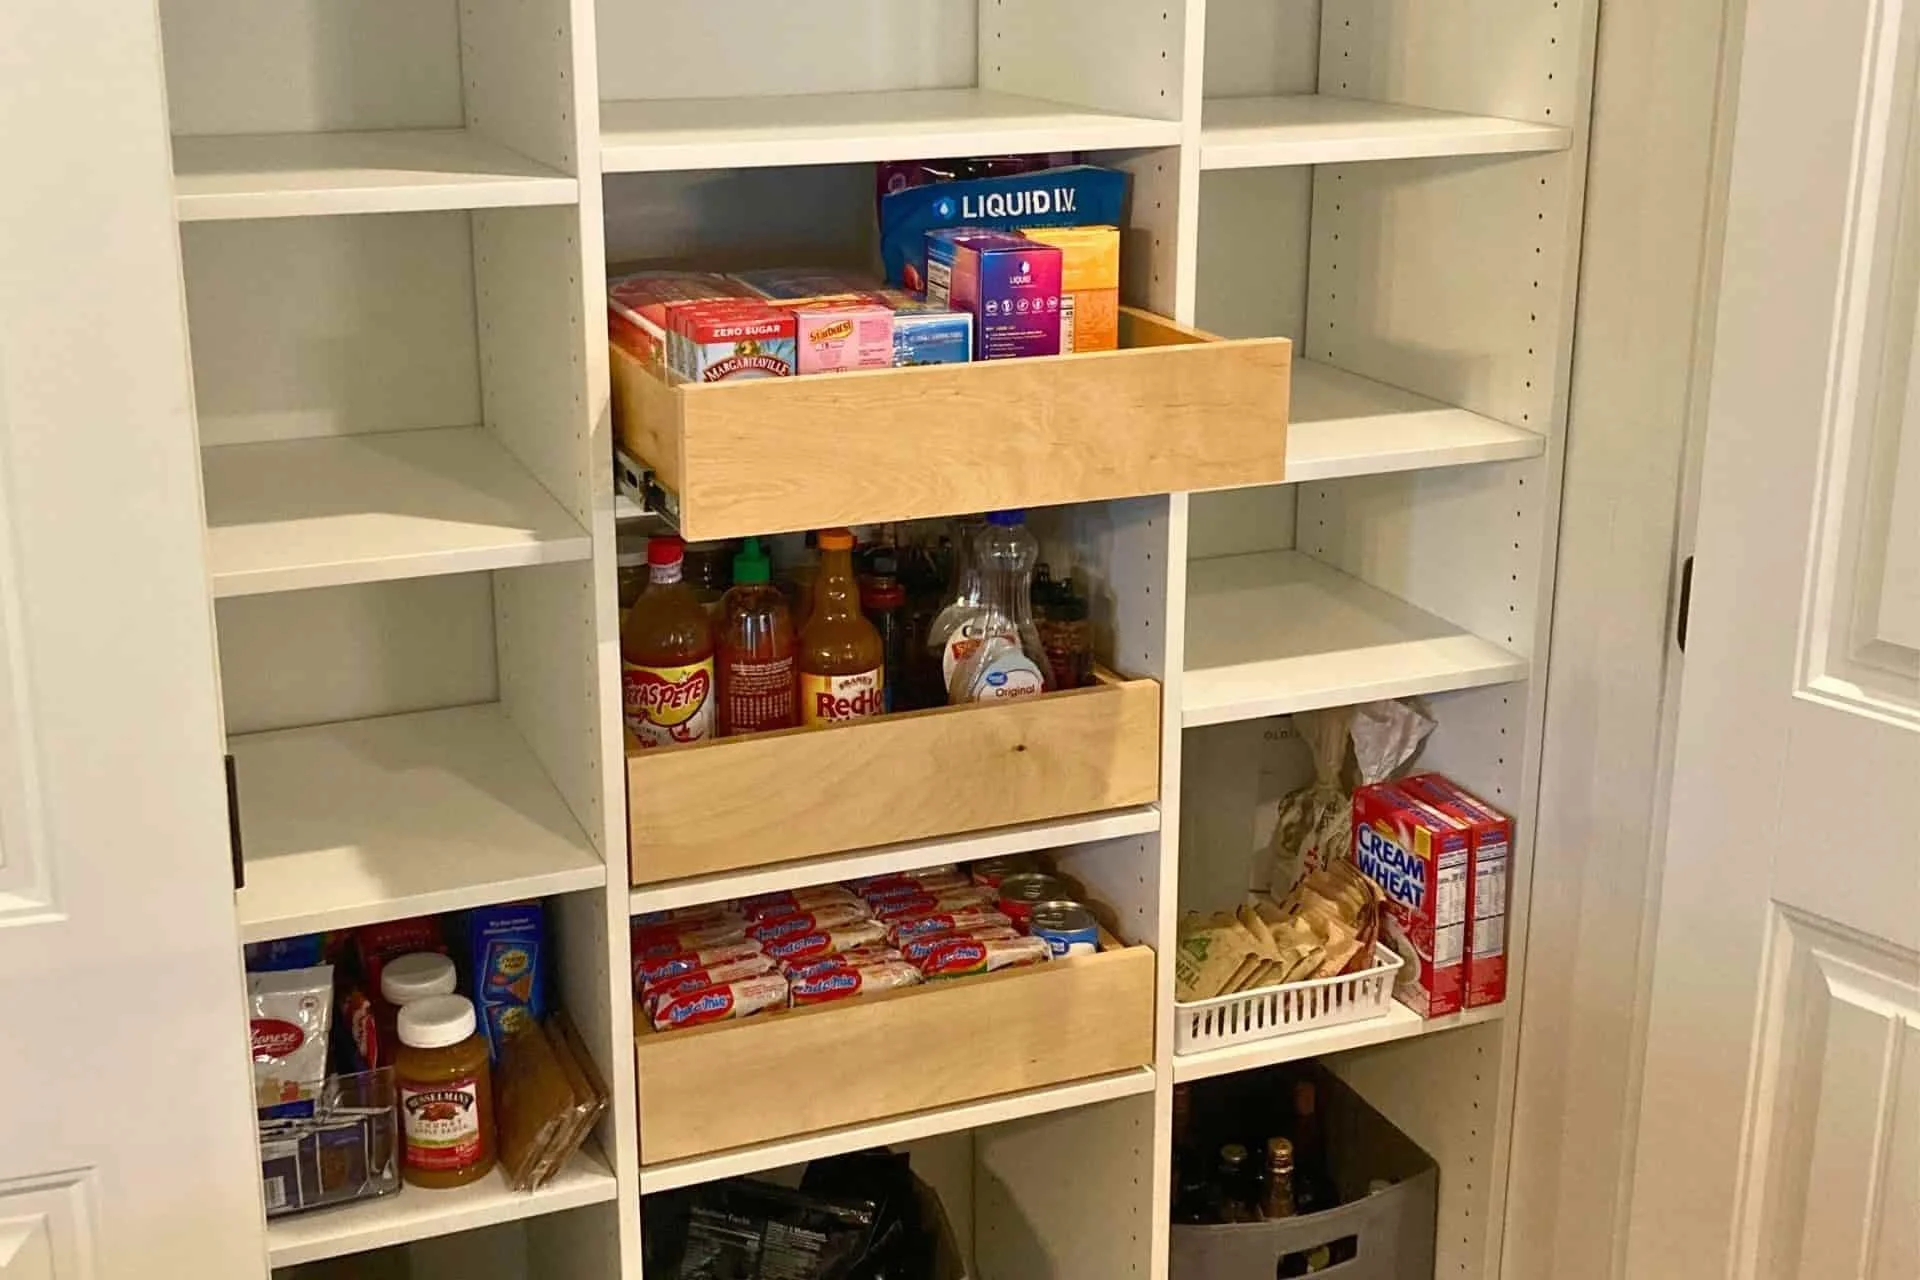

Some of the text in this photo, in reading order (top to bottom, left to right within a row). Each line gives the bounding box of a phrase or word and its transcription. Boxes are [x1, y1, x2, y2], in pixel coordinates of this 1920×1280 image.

[962, 189, 1050, 219] LIQUID
[712, 324, 782, 339] ZERO SUGAR
[705, 357, 789, 382] MARGARITAVILLE
[995, 683, 1035, 698] Original
[1358, 823, 1425, 883] CREAM
[1358, 846, 1425, 909] WHEAT
